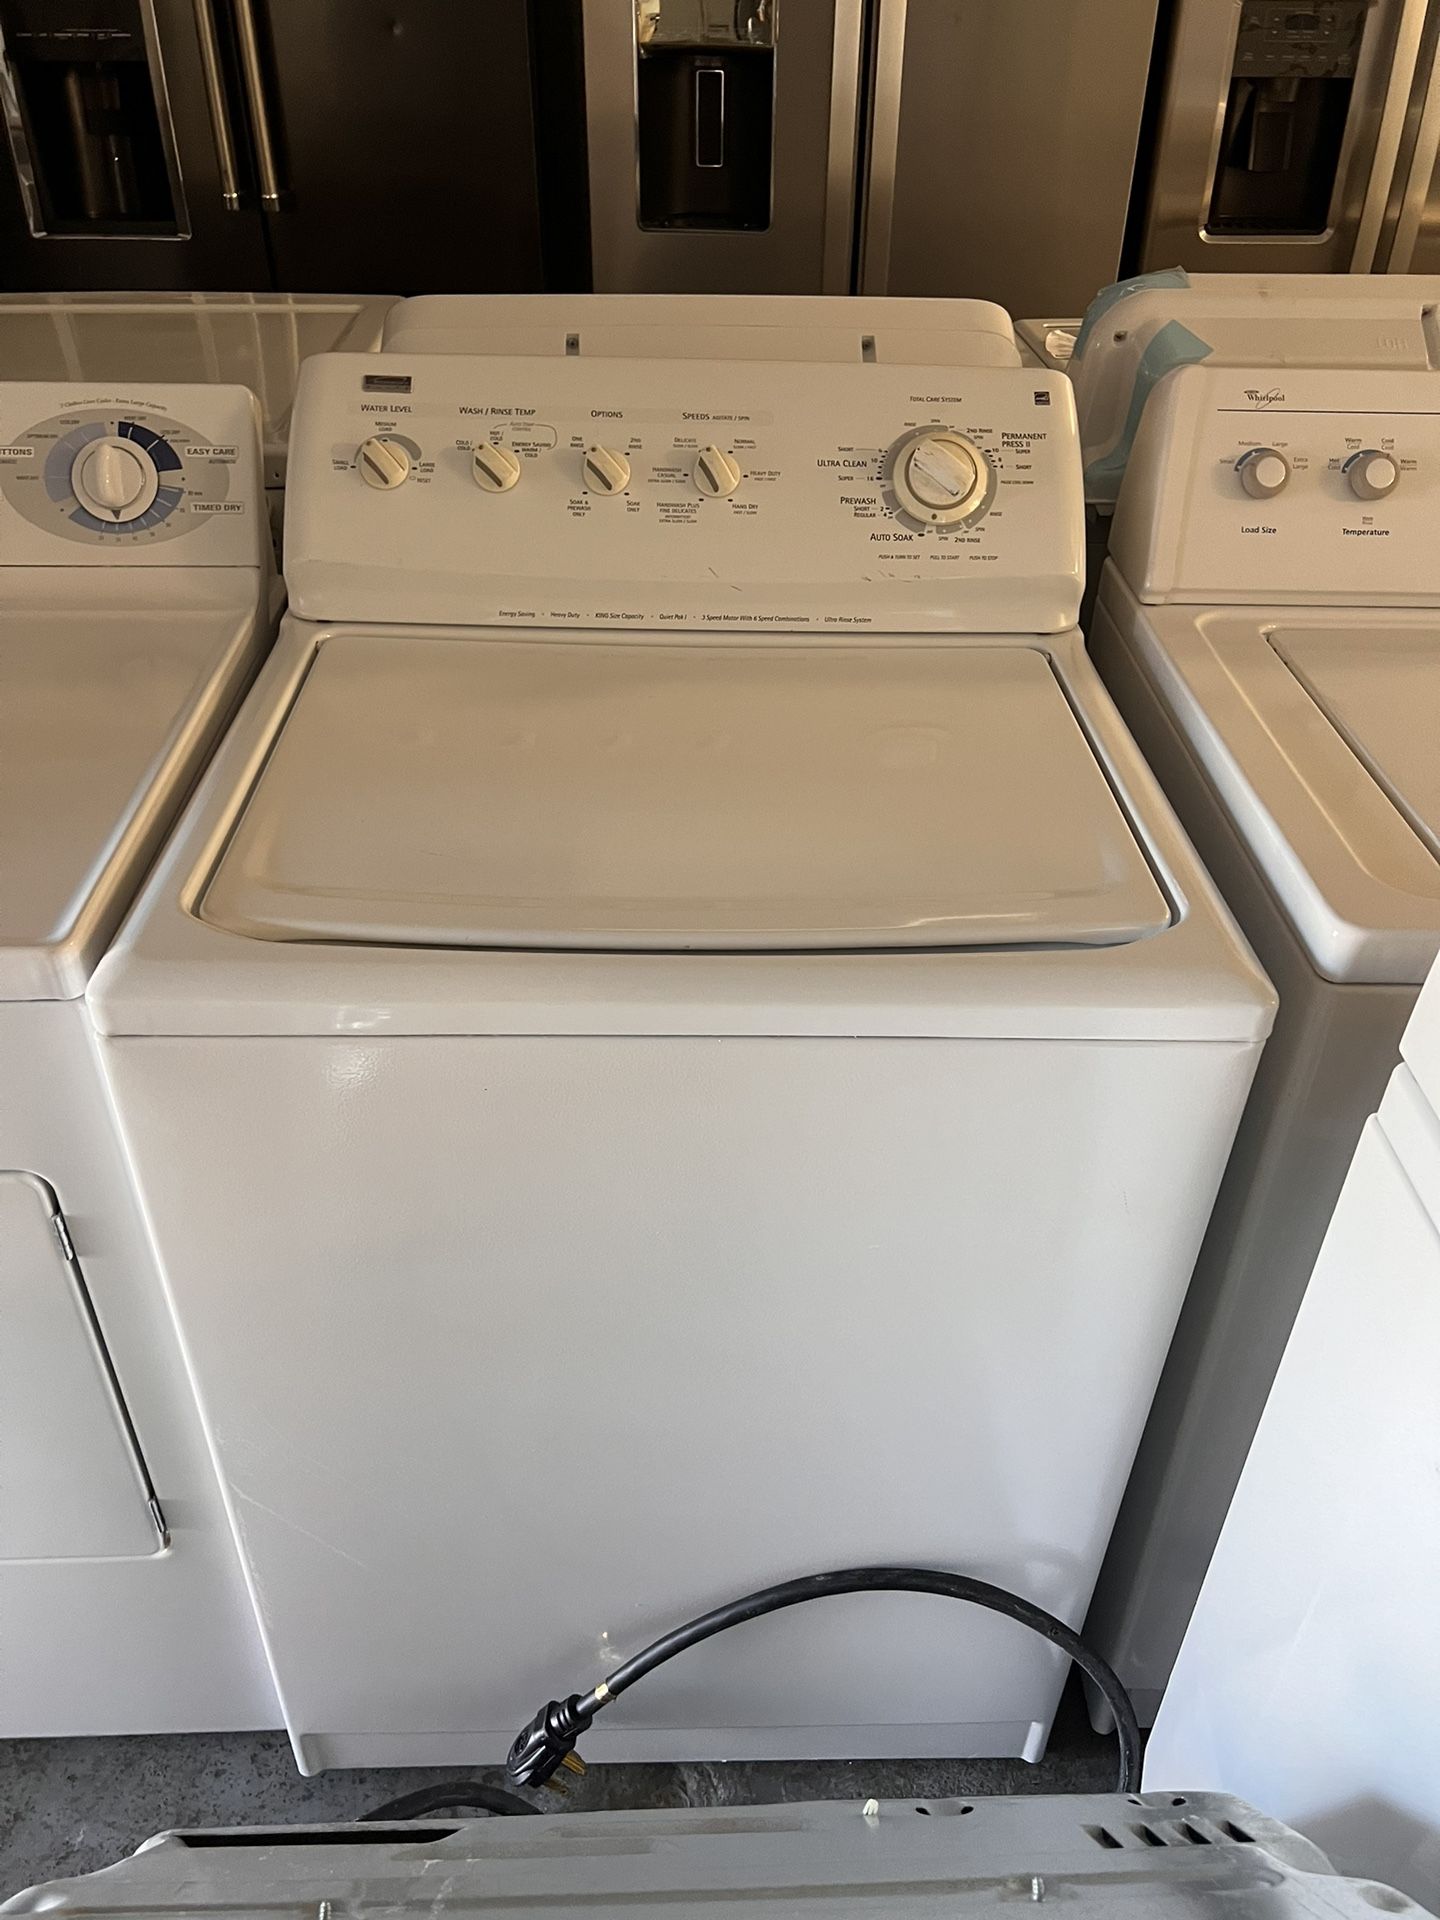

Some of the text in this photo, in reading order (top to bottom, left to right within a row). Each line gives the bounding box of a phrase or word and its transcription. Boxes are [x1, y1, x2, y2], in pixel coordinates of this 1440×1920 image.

[926, 395, 940, 403] CARE
[1243, 389, 1286, 404] Whirlpool
[1001, 432, 1047, 440] PERMANENT
[1001, 440, 1024, 448] PRESS
[186, 447, 211, 457] EASY
[817, 459, 867, 468] ULTRA CLEAN
[840, 496, 877, 505] PREWASH
[193, 503, 222, 512] TIMED
[223, 503, 242, 512] DRY
[1241, 526, 1277, 534] Load Size
[1342, 528, 1390, 536] Temperature
[870, 533, 914, 542] AUTO SOAK
